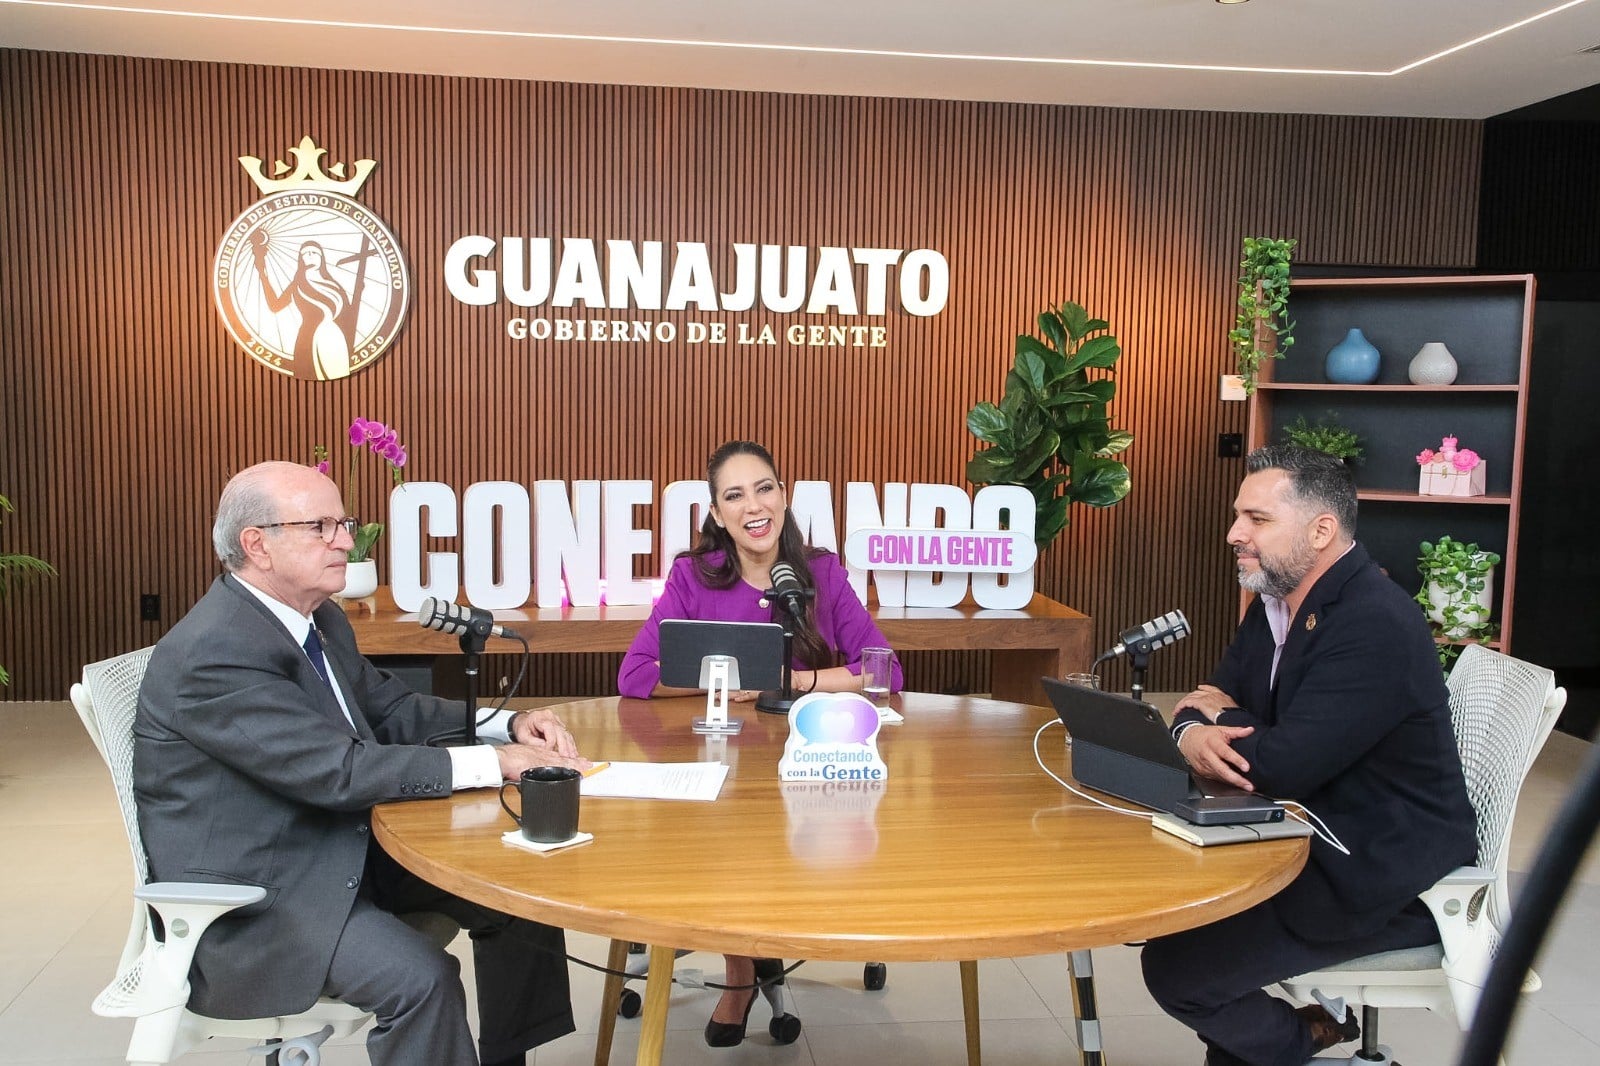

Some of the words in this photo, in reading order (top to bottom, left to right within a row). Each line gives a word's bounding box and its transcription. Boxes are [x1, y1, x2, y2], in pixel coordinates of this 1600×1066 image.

[218, 221, 249, 289] GOBIERNO
[246, 203, 273, 224] DEL
[274, 194, 330, 210] ESTADO
[332, 199, 352, 214] DE
[353, 210, 403, 290] GUANAJUATO
[444, 235, 950, 317] GUANAJUATO
[507, 317, 677, 343] GOBIERNO
[686, 322, 727, 344] DE
[737, 323, 777, 345] LA
[786, 324, 888, 347] GENTE
[245, 337, 282, 367] 2024
[350, 335, 385, 365] 2030
[389, 479, 1037, 613] CONENDO
[868, 534, 914, 565] CON
[917, 535, 943, 565] LA
[947, 535, 1014, 567] GENTE
[793, 748, 873, 763] Conectando
[787, 769, 807, 777] con
[810, 767, 820, 777] la
[822, 764, 882, 780] Gente
